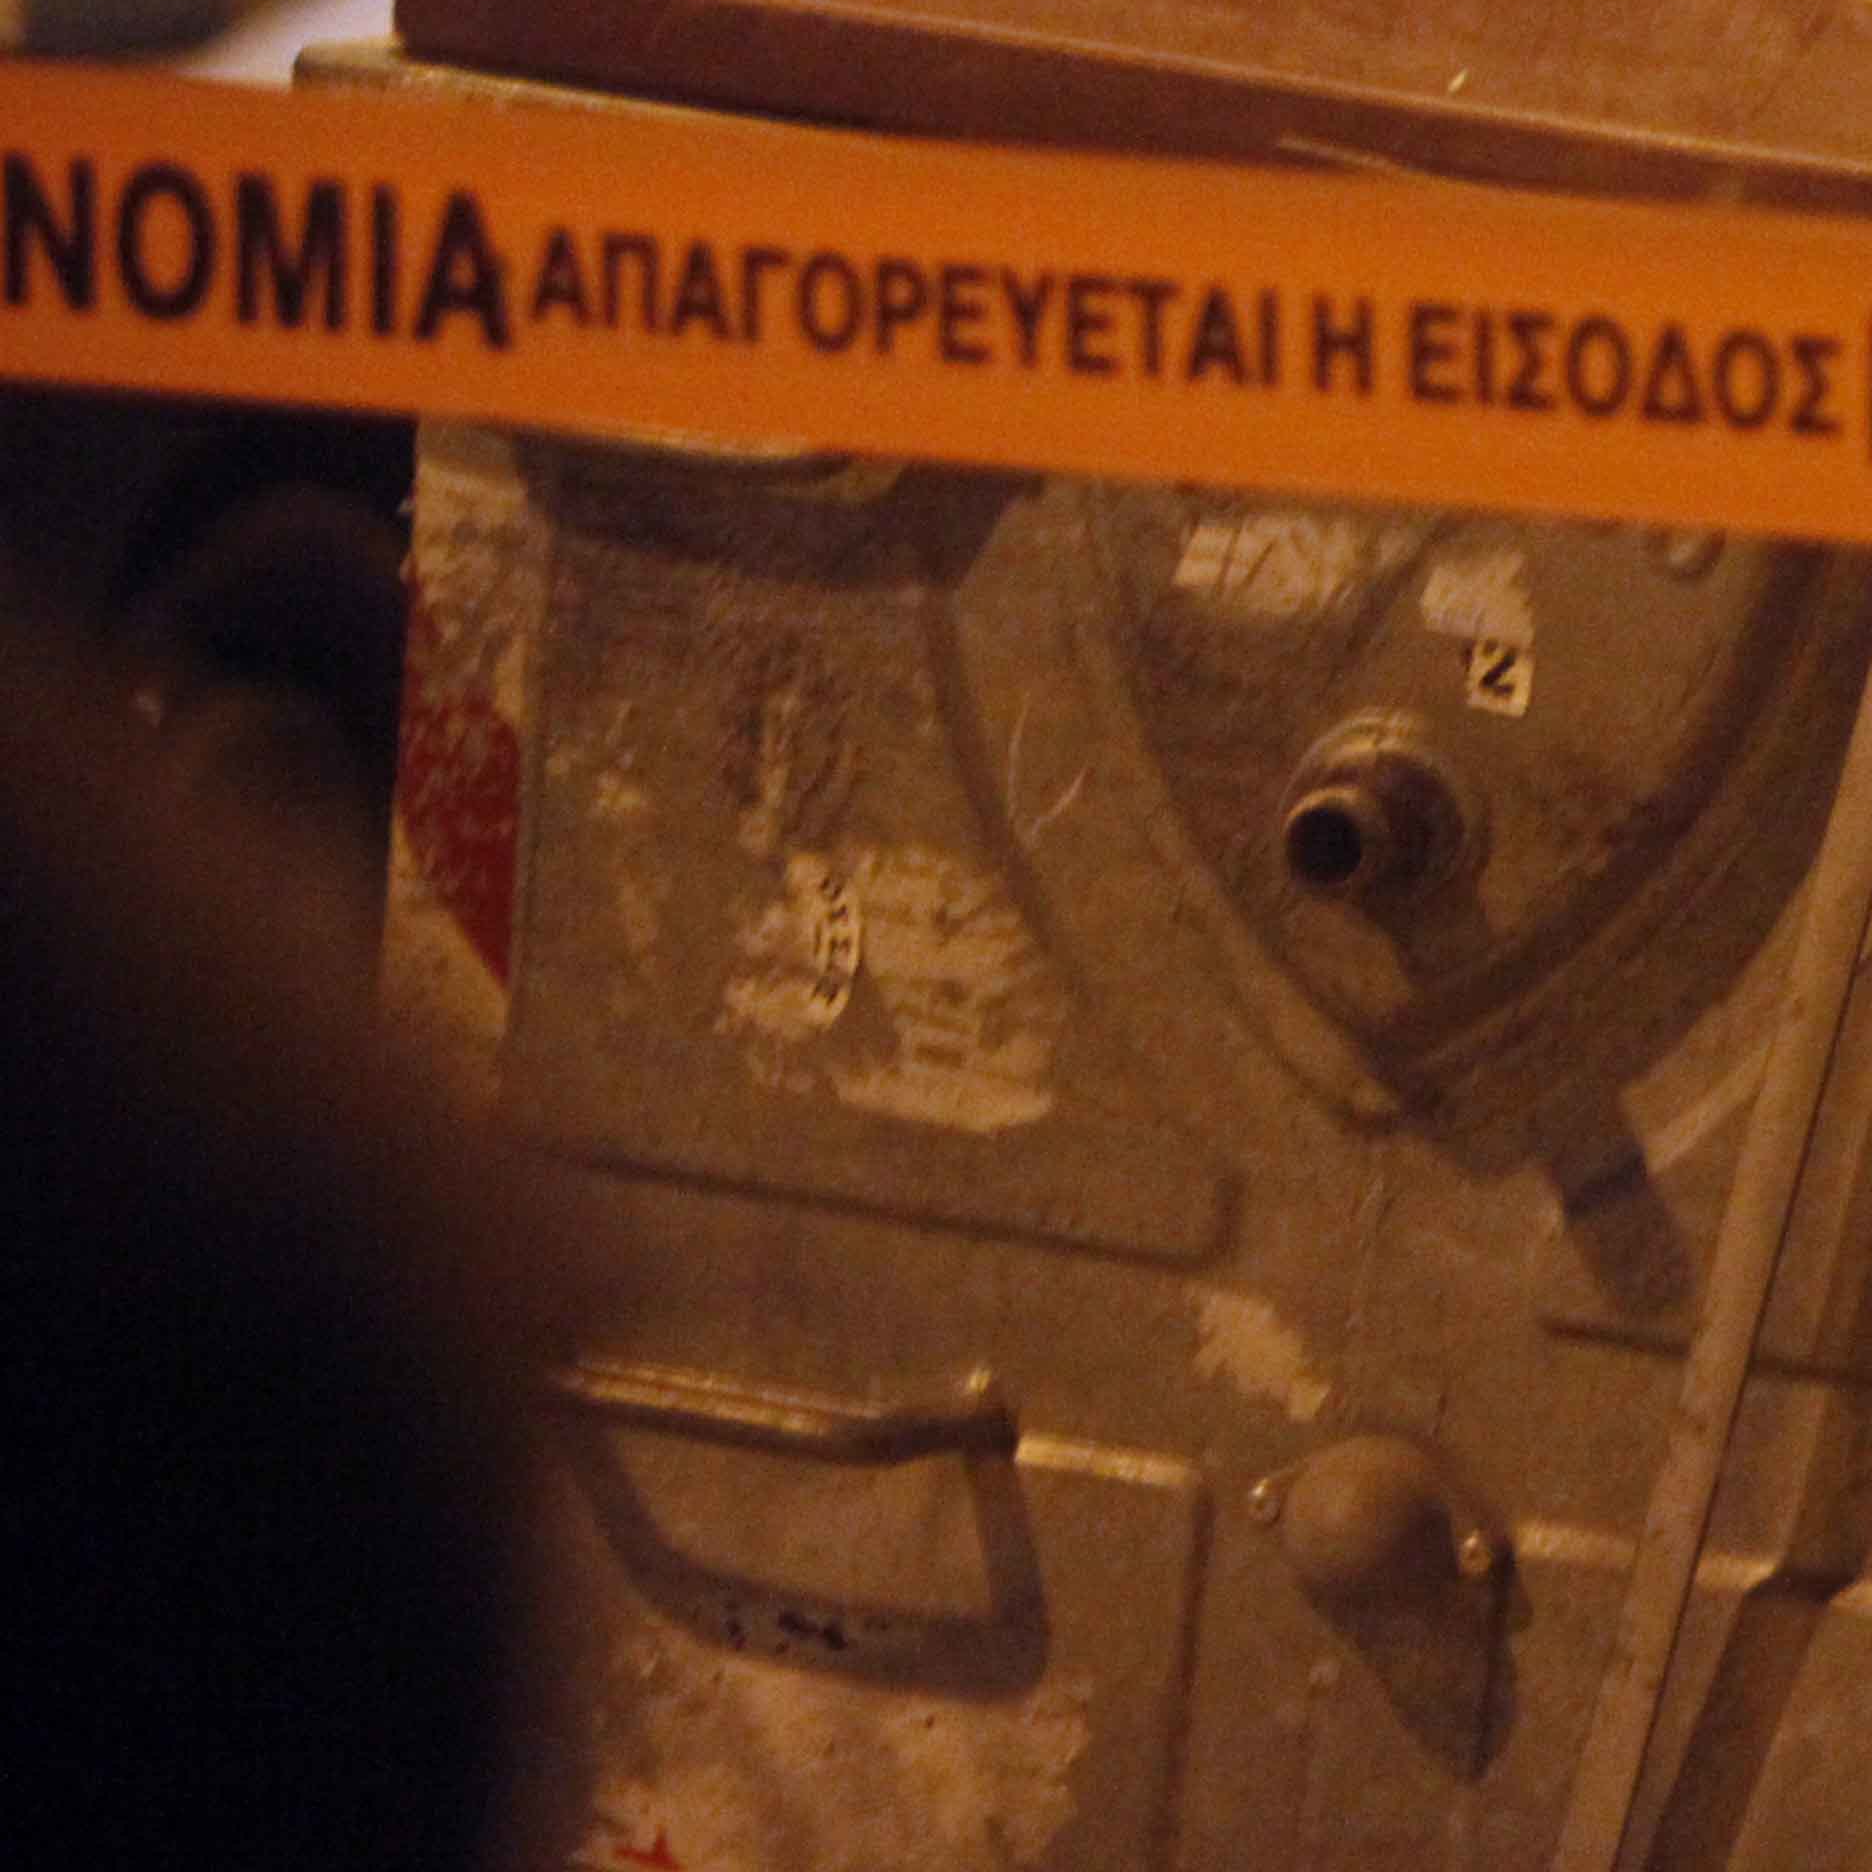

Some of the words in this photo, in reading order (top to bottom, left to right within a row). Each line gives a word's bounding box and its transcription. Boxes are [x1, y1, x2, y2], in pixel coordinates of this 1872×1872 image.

[531, 225, 1284, 394] ΑΠΑΓΟΡΕΥΕΤΑΙ
[1309, 291, 1377, 397] Η
[1406, 300, 1843, 438] ΕΙΣΟΔΟΣ
